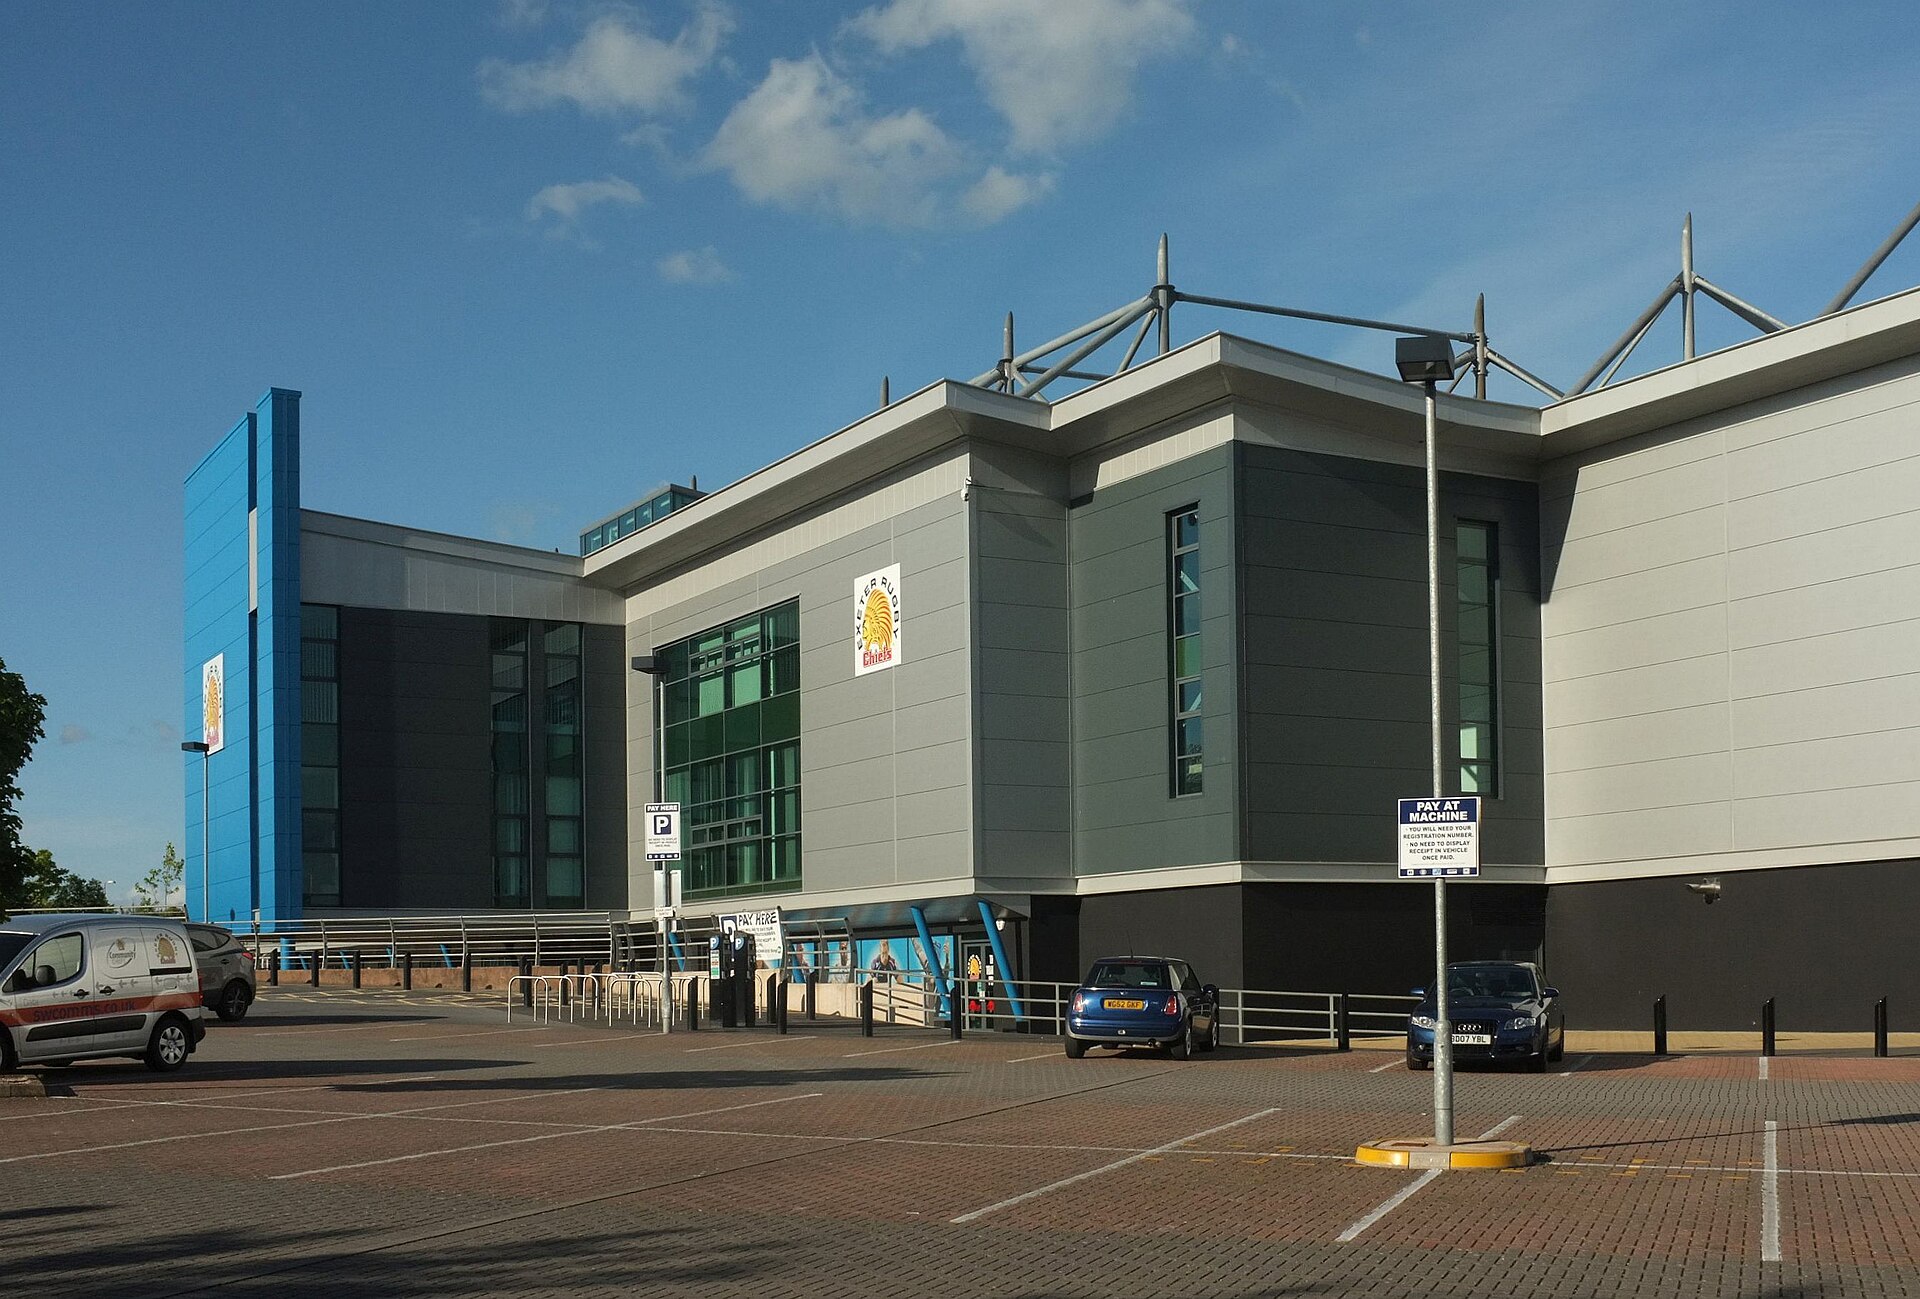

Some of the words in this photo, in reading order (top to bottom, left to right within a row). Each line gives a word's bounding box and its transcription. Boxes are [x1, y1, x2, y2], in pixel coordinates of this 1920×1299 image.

[856, 577, 877, 650] EXETER
[880, 576, 899, 639] RUGBY
[863, 645, 893, 668] Chiefs
[1417, 801, 1440, 811] PAY
[1444, 801, 1460, 811] AT
[1409, 811, 1468, 822] MACHINE
[656, 816, 669, 834] P
[738, 913, 754, 926] PAY
[755, 911, 777, 926] HERE
[1472, 1035, 1486, 1043] YBL
